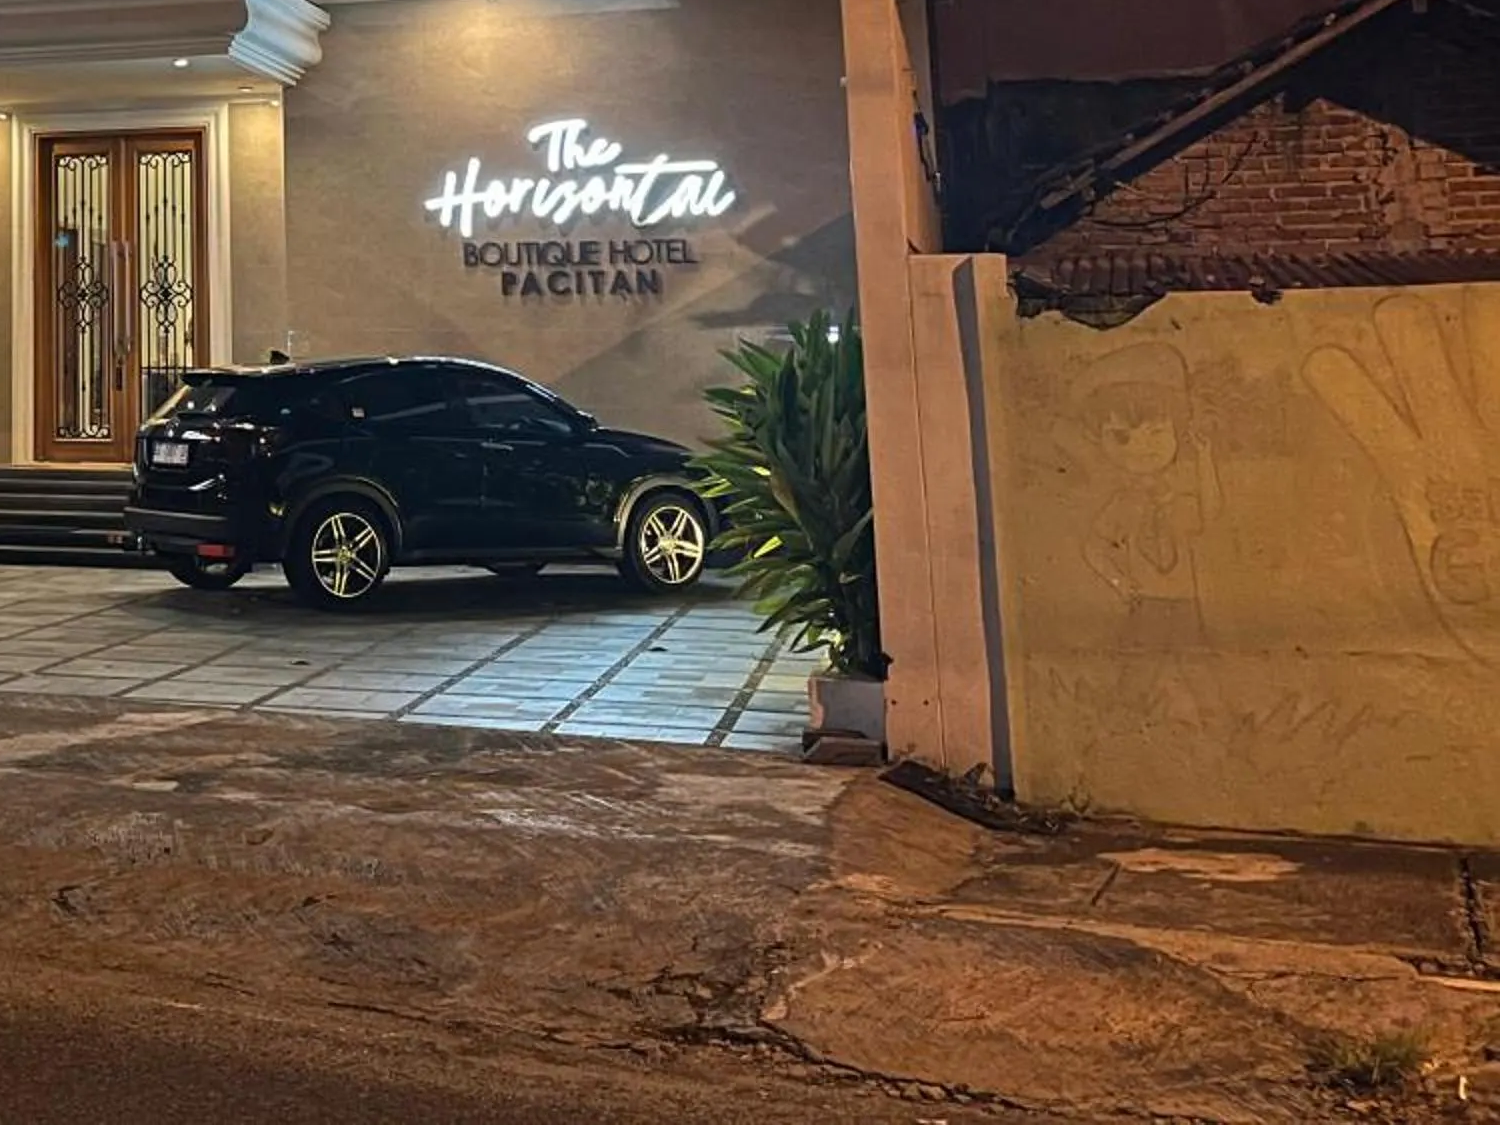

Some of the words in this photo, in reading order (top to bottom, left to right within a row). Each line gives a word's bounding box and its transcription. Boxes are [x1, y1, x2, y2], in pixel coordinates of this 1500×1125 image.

[527, 118, 622, 172] The
[424, 153, 736, 237] Horisontal
[462, 239, 599, 267] BOUTIQUE
[609, 238, 699, 265] HOTEL
[500, 270, 660, 296] PACITAN
